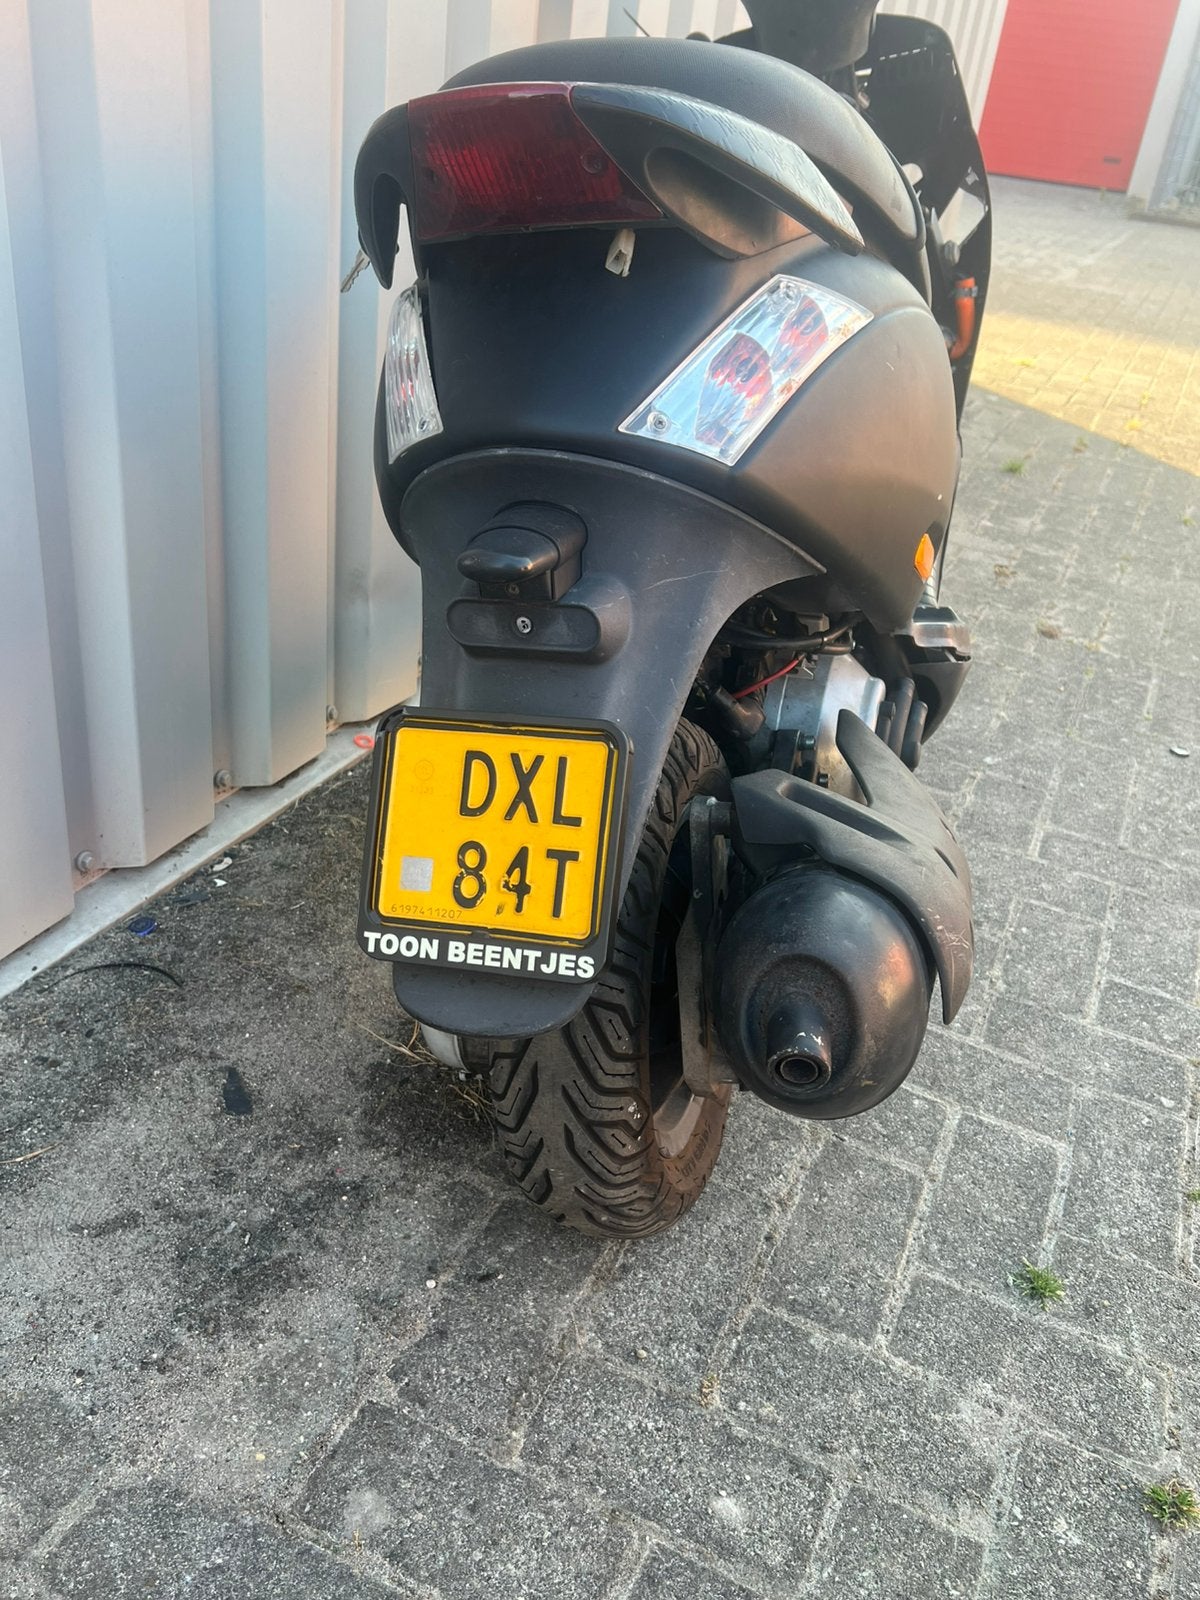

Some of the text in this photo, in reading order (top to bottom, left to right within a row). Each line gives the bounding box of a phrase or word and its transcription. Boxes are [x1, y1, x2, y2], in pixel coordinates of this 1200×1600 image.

[460, 750, 582, 827] DXL
[453, 840, 580, 918] 84T
[364, 931, 595, 979] TOON BEENTJES
